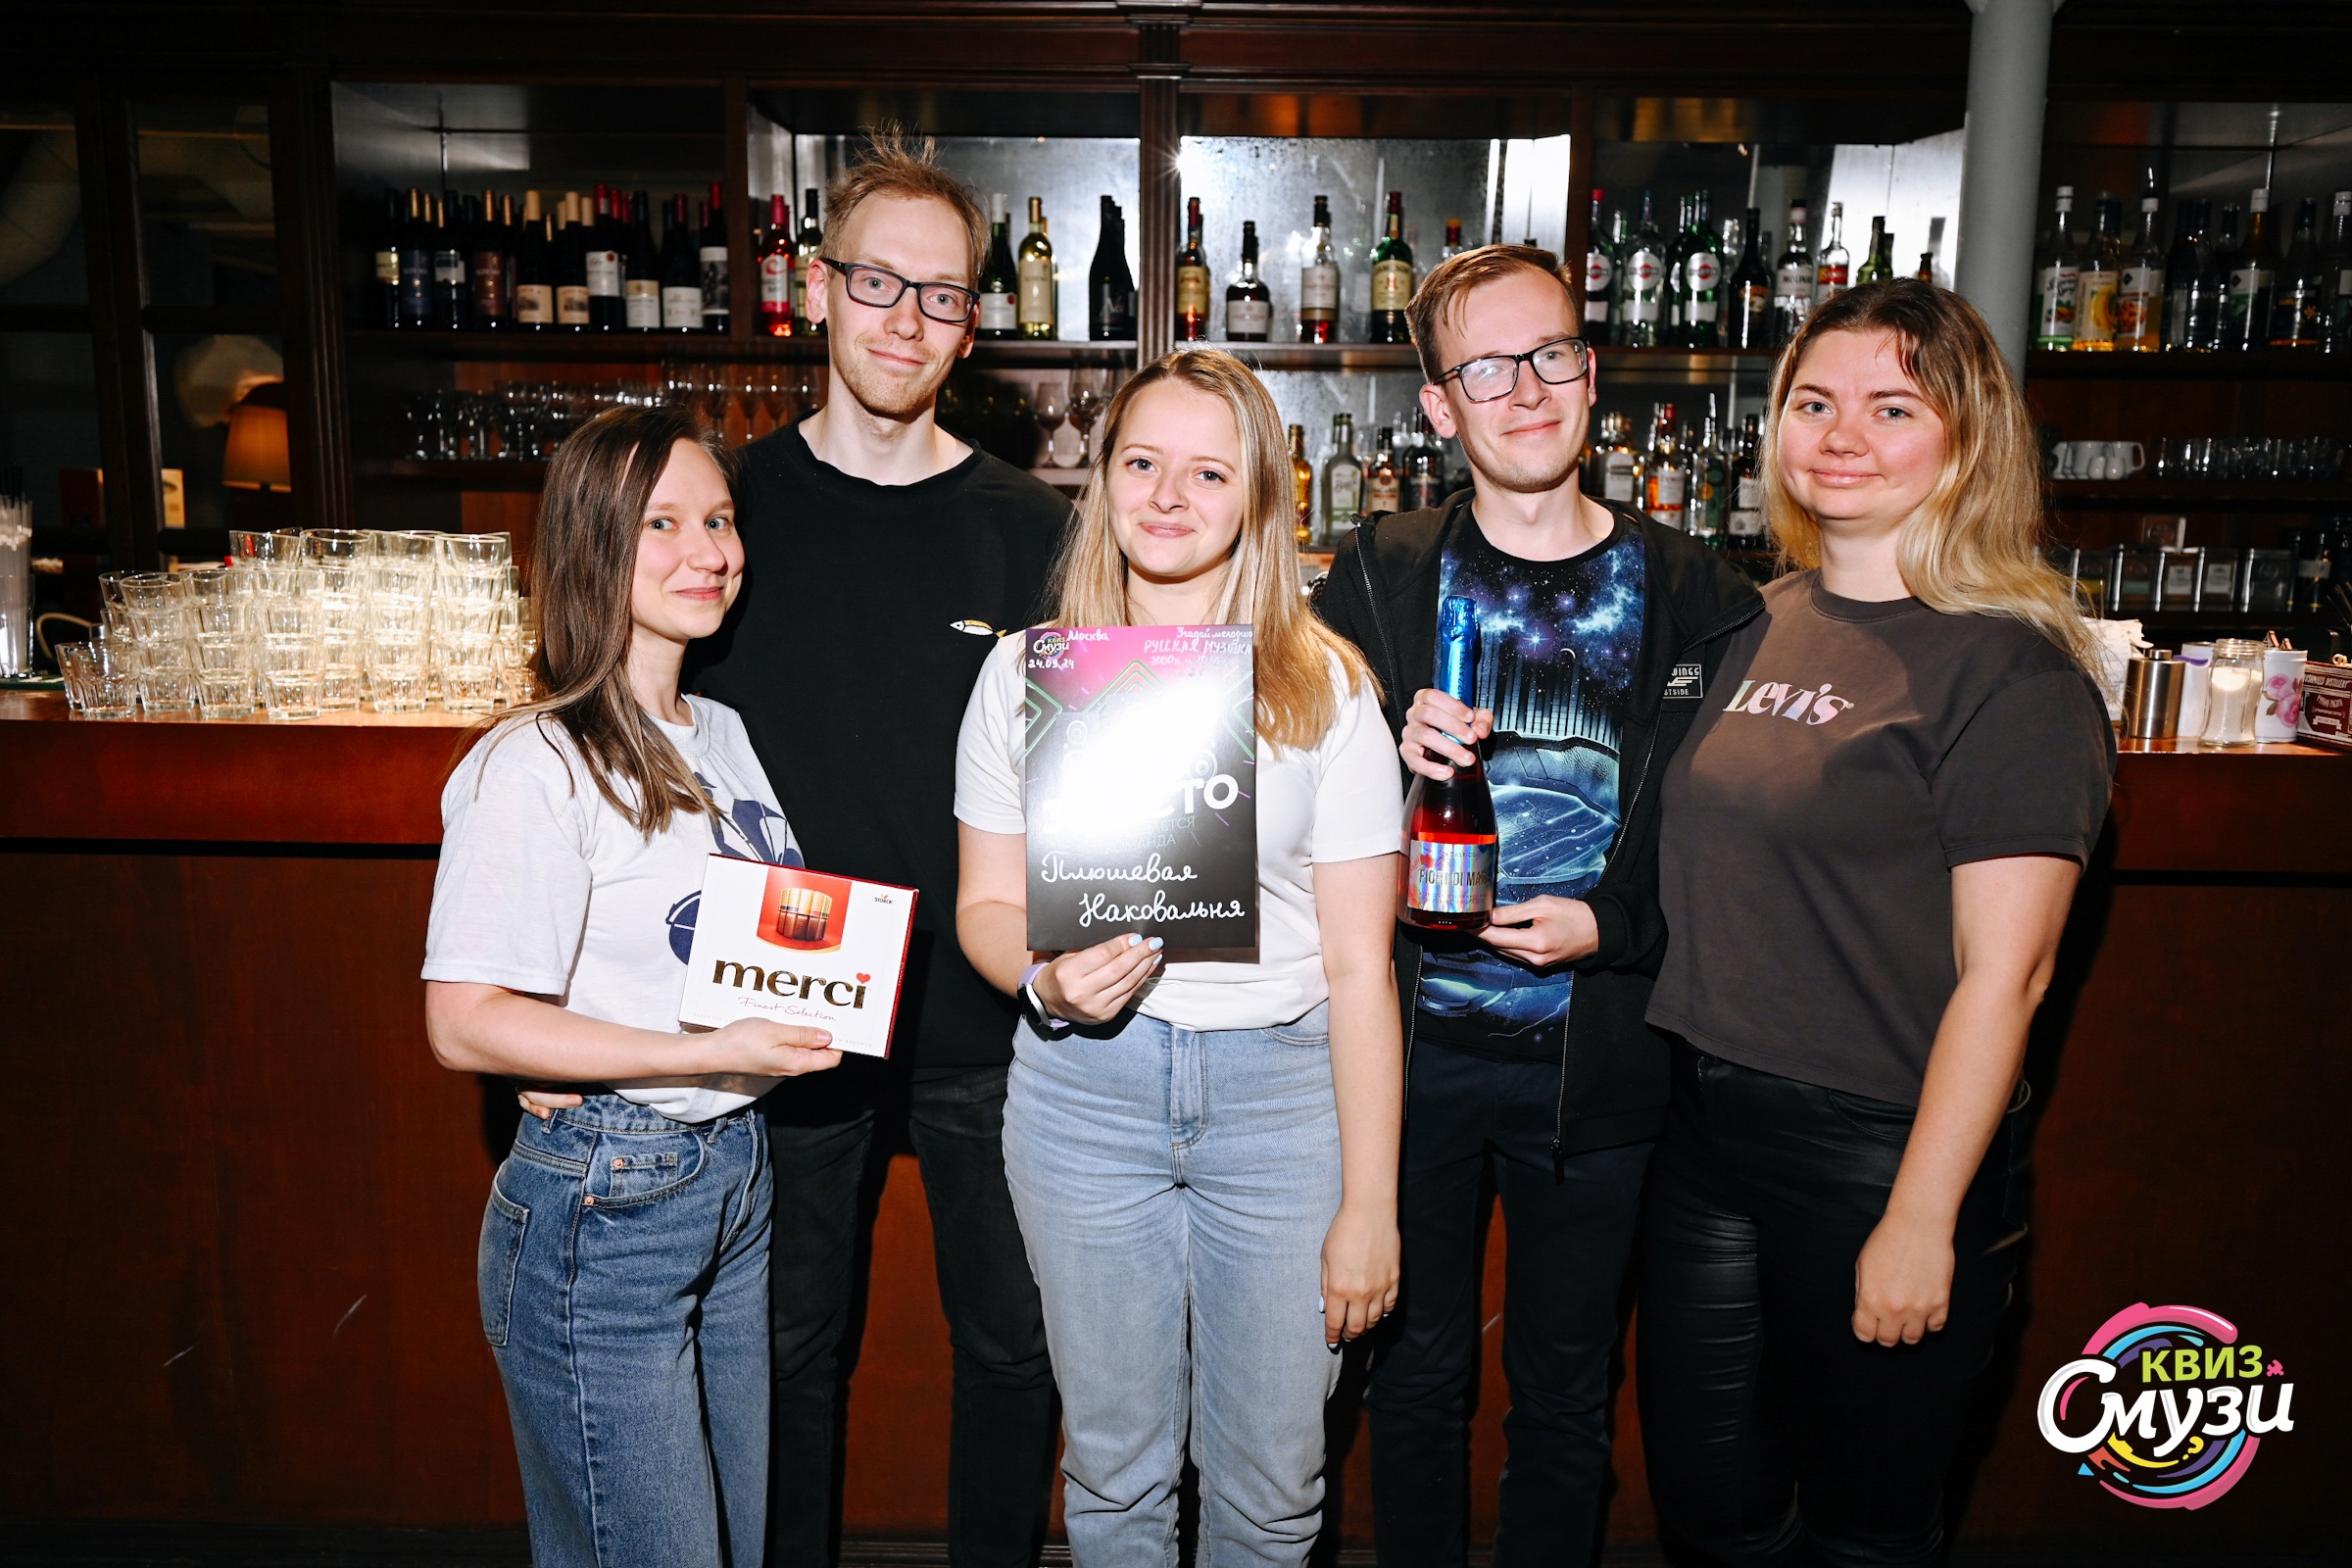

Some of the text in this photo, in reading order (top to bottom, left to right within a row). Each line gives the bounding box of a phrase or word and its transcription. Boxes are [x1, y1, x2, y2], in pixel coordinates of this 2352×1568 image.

[1033, 638, 1070, 655] Смузи
[1067, 629, 1109, 642] Москва
[1144, 639, 1199, 654] РУССКАЯ
[1456, 648, 1467, 703] RIZZANTE
[1041, 850, 1198, 883] Плюшевая
[1079, 889, 1246, 928] Наковальня
[712, 959, 871, 1009] merci
[738, 995, 838, 1022] Finest Selection
